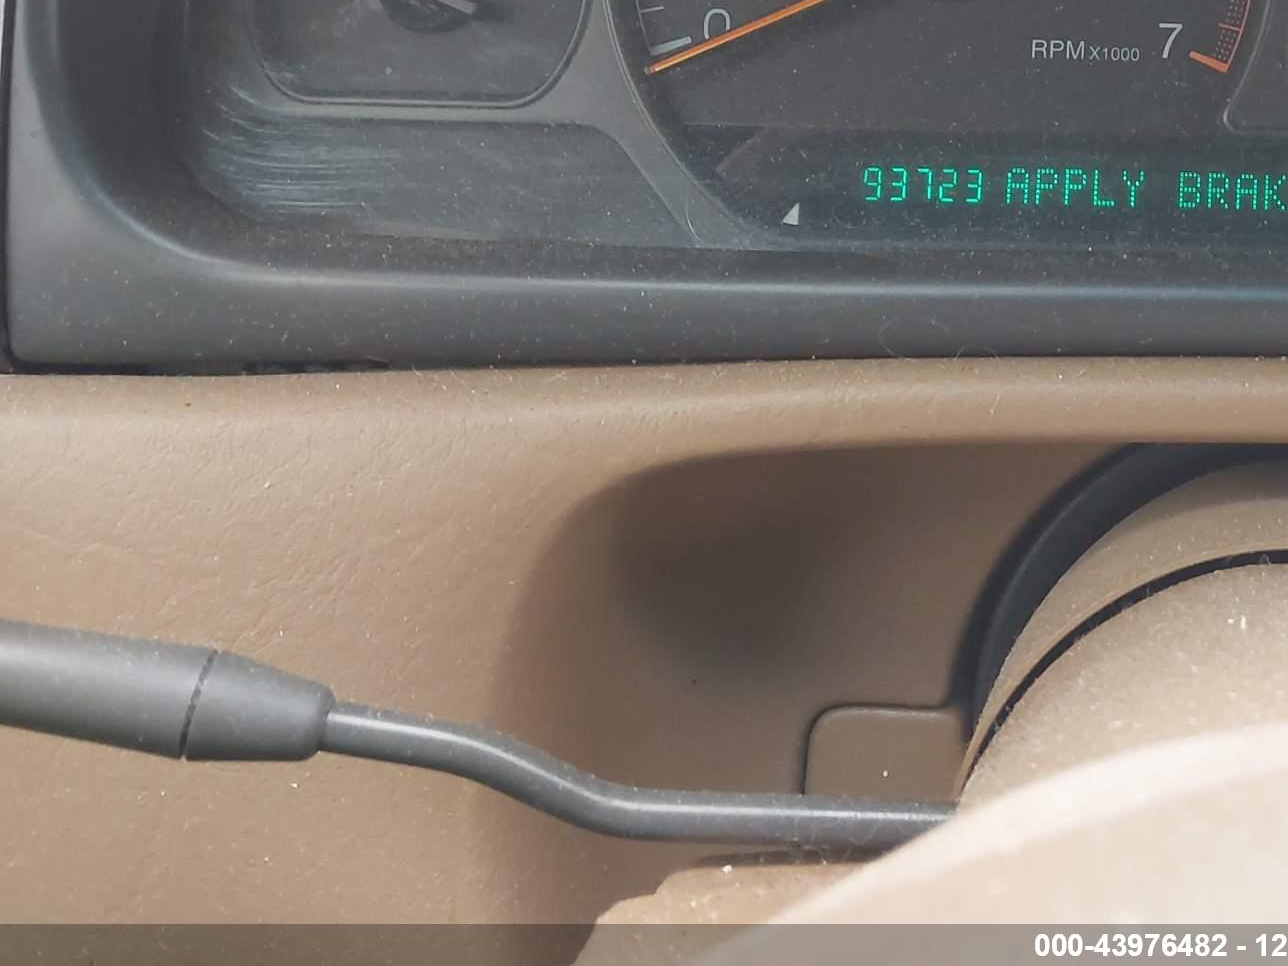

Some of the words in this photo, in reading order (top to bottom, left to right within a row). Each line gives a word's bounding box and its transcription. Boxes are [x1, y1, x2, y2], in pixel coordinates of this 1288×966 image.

[1031, 39, 1086, 60] RPM
[1158, 22, 1183, 59] 7
[862, 166, 984, 203] 93723
[1006, 167, 1145, 207] APPLY
